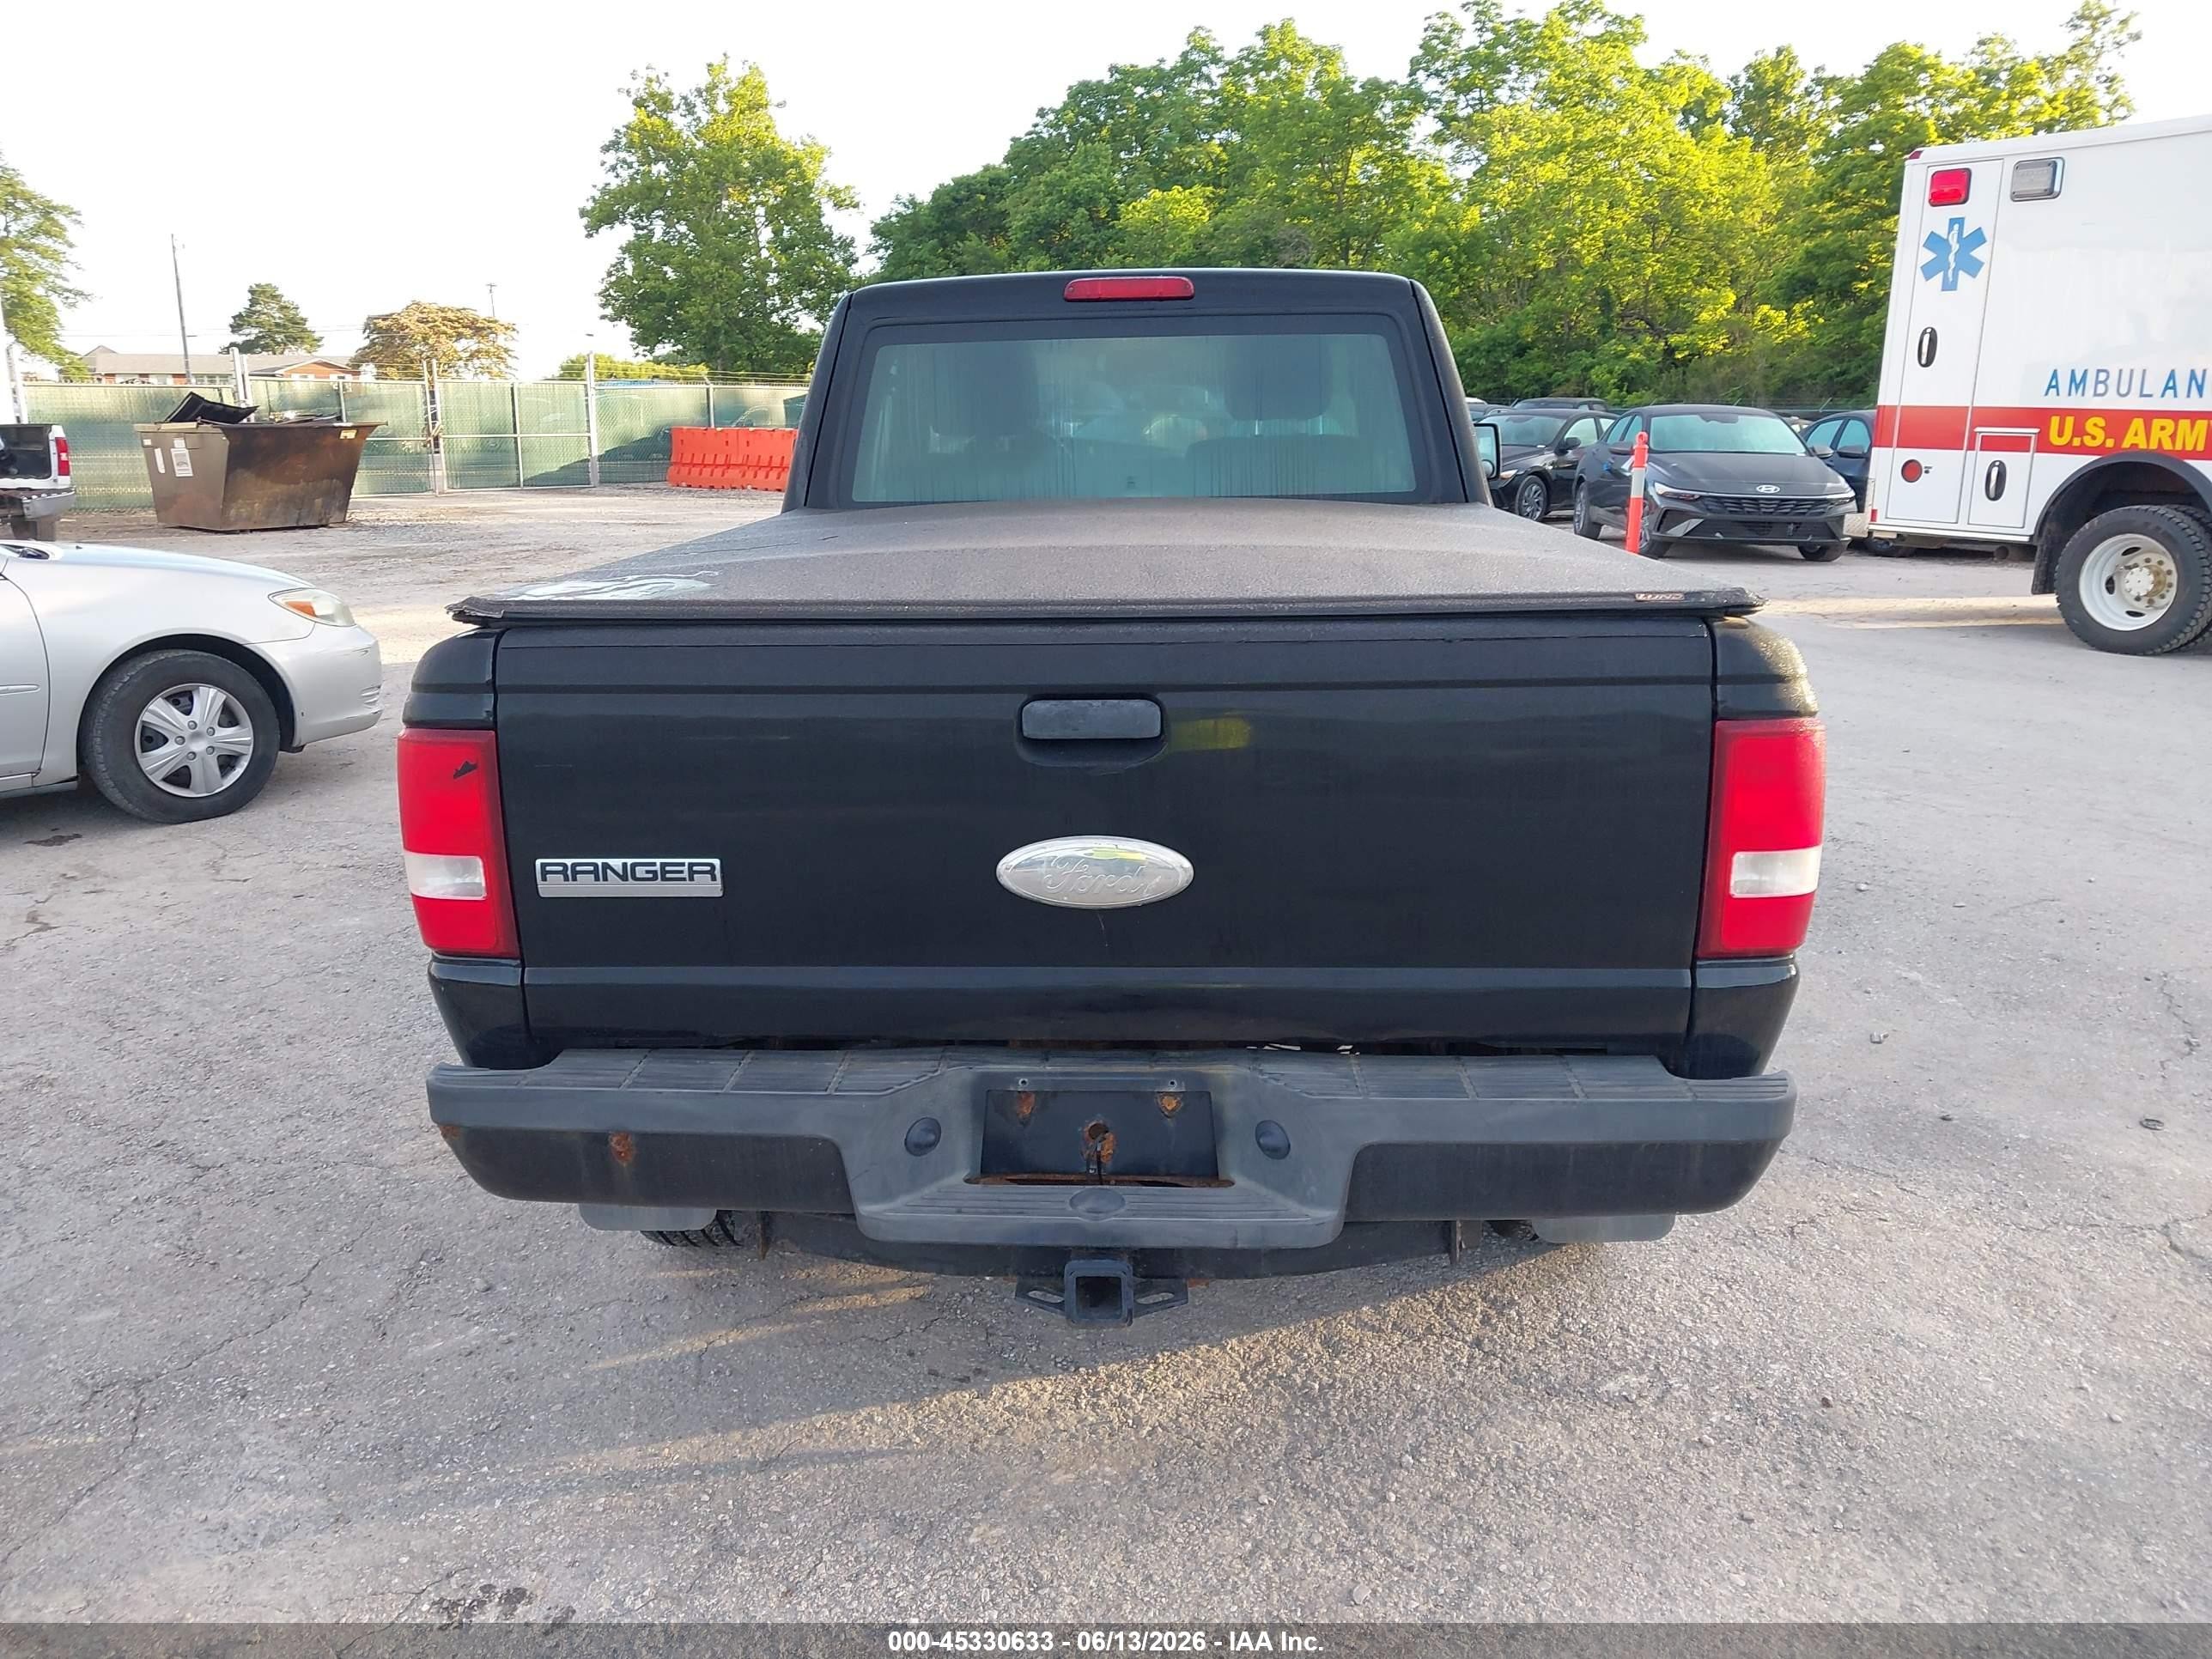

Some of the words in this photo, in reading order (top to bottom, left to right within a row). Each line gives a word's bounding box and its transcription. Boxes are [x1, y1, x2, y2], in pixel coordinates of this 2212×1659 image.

[2044, 368, 2212, 398] AMBULAN
[2049, 416, 2115, 448] U.S.
[2121, 417, 2212, 452] ARM
[539, 861, 717, 883] RANGER
[1042, 855, 1149, 895] Ford
